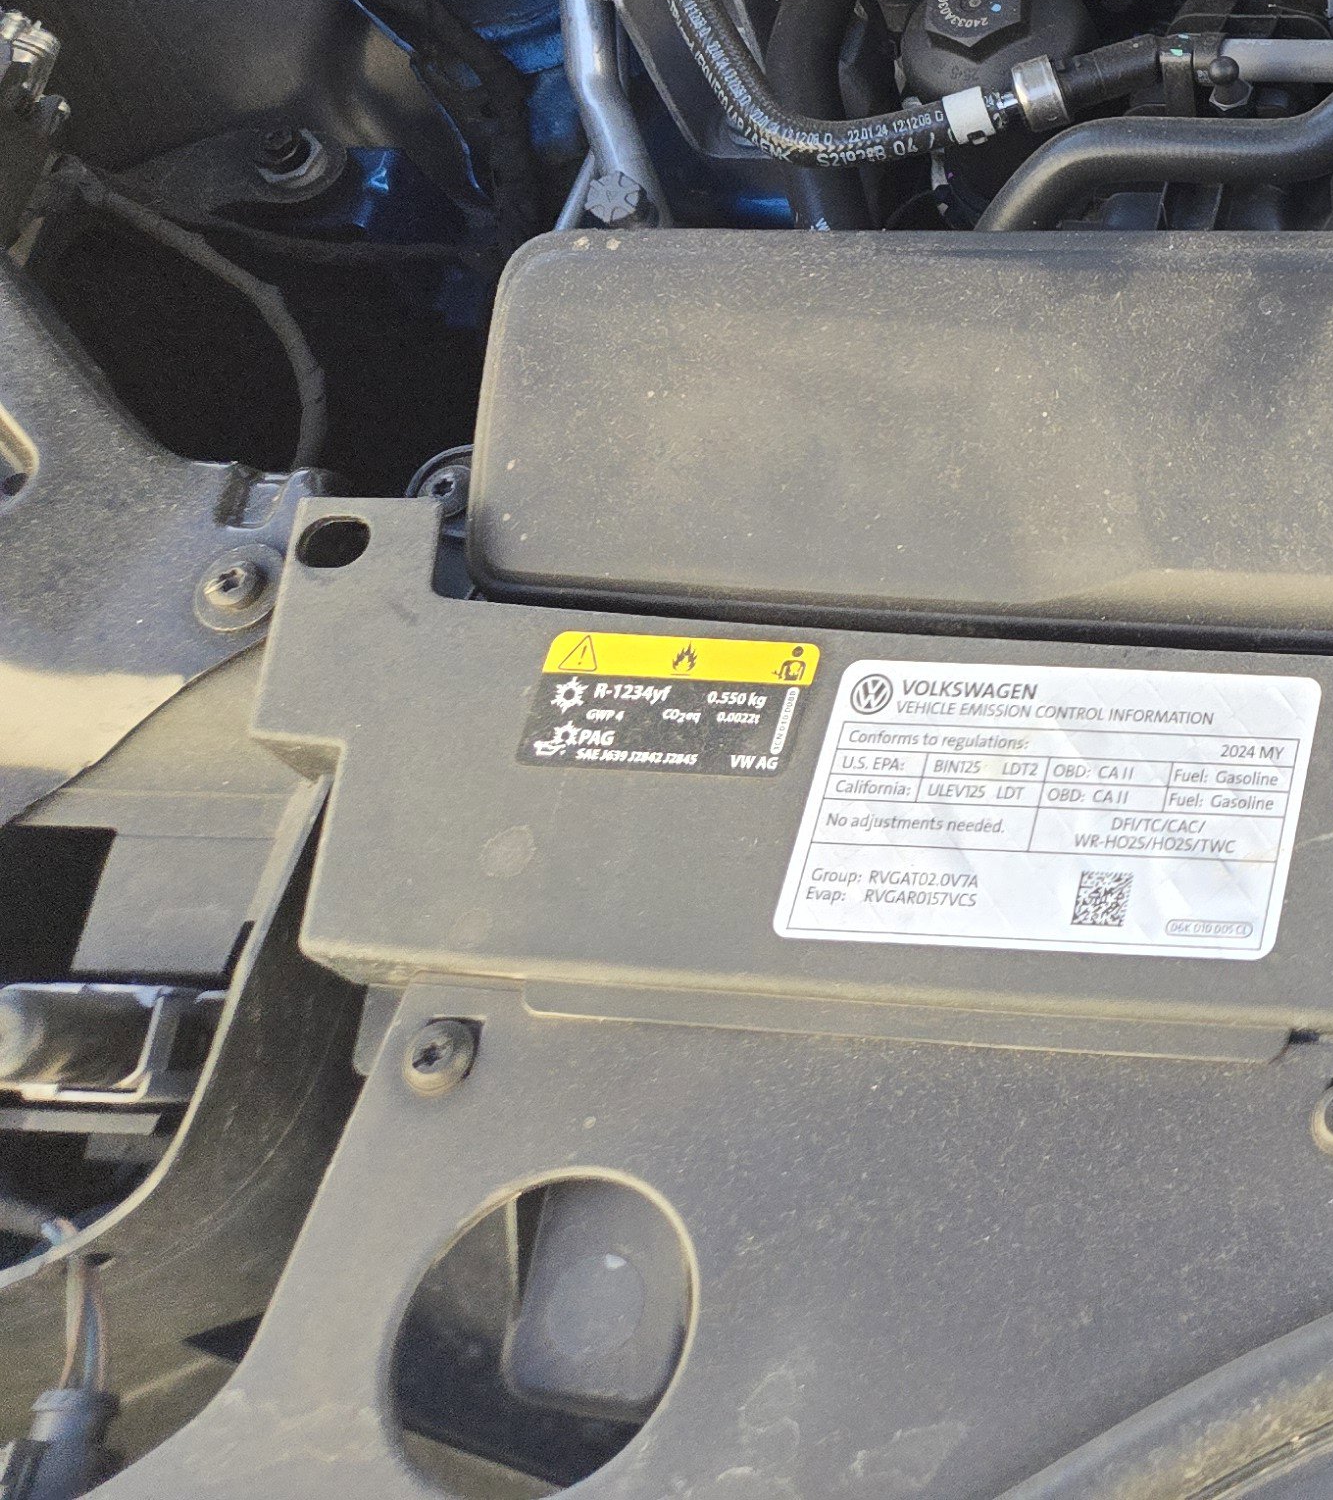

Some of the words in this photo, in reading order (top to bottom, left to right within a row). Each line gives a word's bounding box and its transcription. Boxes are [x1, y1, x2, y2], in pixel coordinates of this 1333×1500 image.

[593, 682, 672, 704] R-1234yf
[708, 690, 746, 704] 0.550
[748, 693, 768, 708] kg
[903, 679, 1038, 700] VOLKSWAGEN
[586, 709, 614, 721] GWP
[614, 711, 625, 721] 4
[897, 701, 957, 714] VEHICLE
[959, 703, 1033, 718] EMISSION
[1035, 705, 1105, 721] CONTROL
[1108, 708, 1214, 725] INFORMATION
[578, 729, 616, 746] PAG
[849, 729, 919, 745] Conforms
[922, 731, 938, 745] to
[942, 734, 1030, 751] regulations:
[575, 749, 600, 760] SAE
[730, 755, 758, 768] VW
[756, 756, 779, 770] AG
[1221, 744, 1256, 758] 2024
[1259, 747, 1285, 760] MY
[842, 756, 869, 770] U.S.
[873, 757, 905, 771] EPA:
[933, 759, 981, 774] BIN125
[1002, 763, 1038, 777] LDT2
[1053, 764, 1091, 779] OBD:
[1172, 769, 1209, 783] Fuel:
[1216, 770, 1278, 786] Gasoline
[836, 780, 912, 797] California:
[928, 784, 986, 798] ULEV125
[996, 786, 1025, 800] LDT
[1048, 788, 1086, 802] OBD:
[1169, 793, 1204, 807] Fuel:
[1210, 795, 1275, 810] Gasoline
[826, 813, 848, 827] No
[851, 813, 943, 832] adjustments
[947, 818, 1005, 834] needed.
[1111, 817, 1206, 833] DFI/TC/CAC/
[1075, 834, 1236, 854] WR-HO2S/HO2S/TWC
[811, 868, 861, 886] Group:
[806, 886, 846, 905] Evap:
